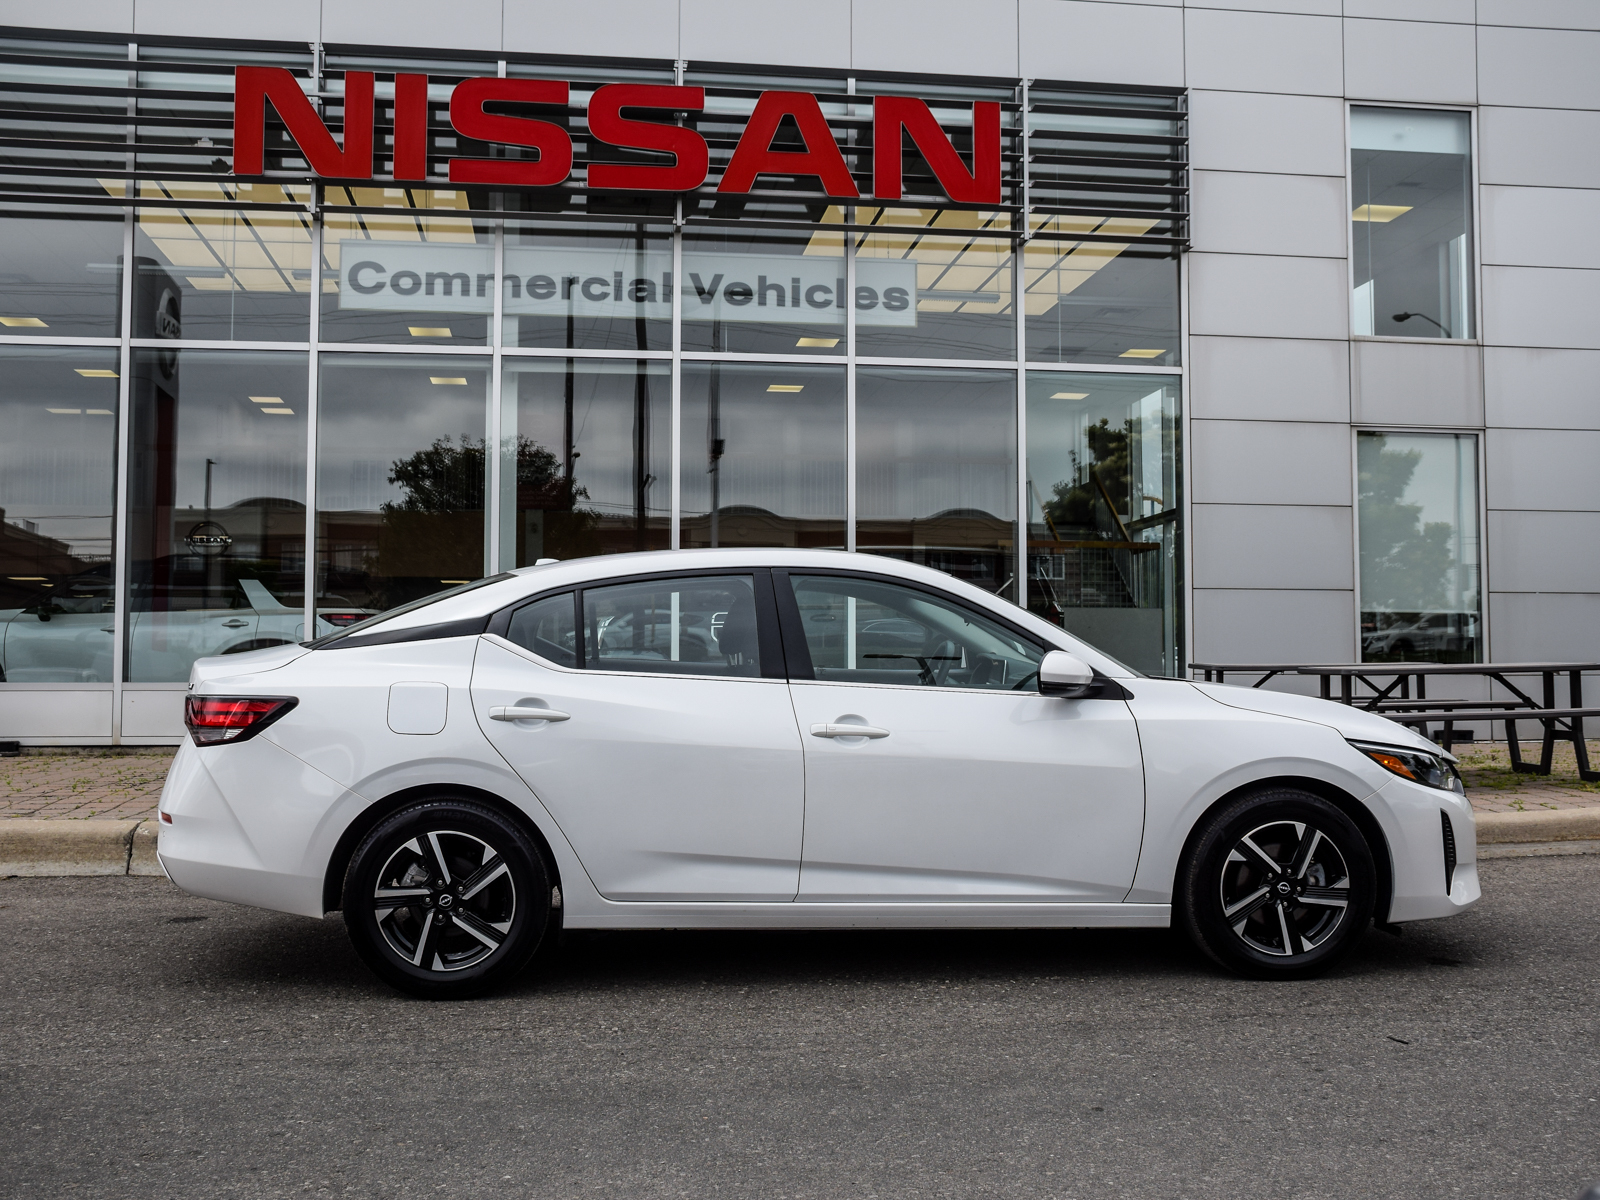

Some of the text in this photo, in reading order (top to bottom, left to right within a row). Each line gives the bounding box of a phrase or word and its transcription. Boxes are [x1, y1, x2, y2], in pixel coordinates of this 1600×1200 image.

[233, 65, 1002, 205] NISSAN
[347, 259, 910, 313] Commercial Vehicles
